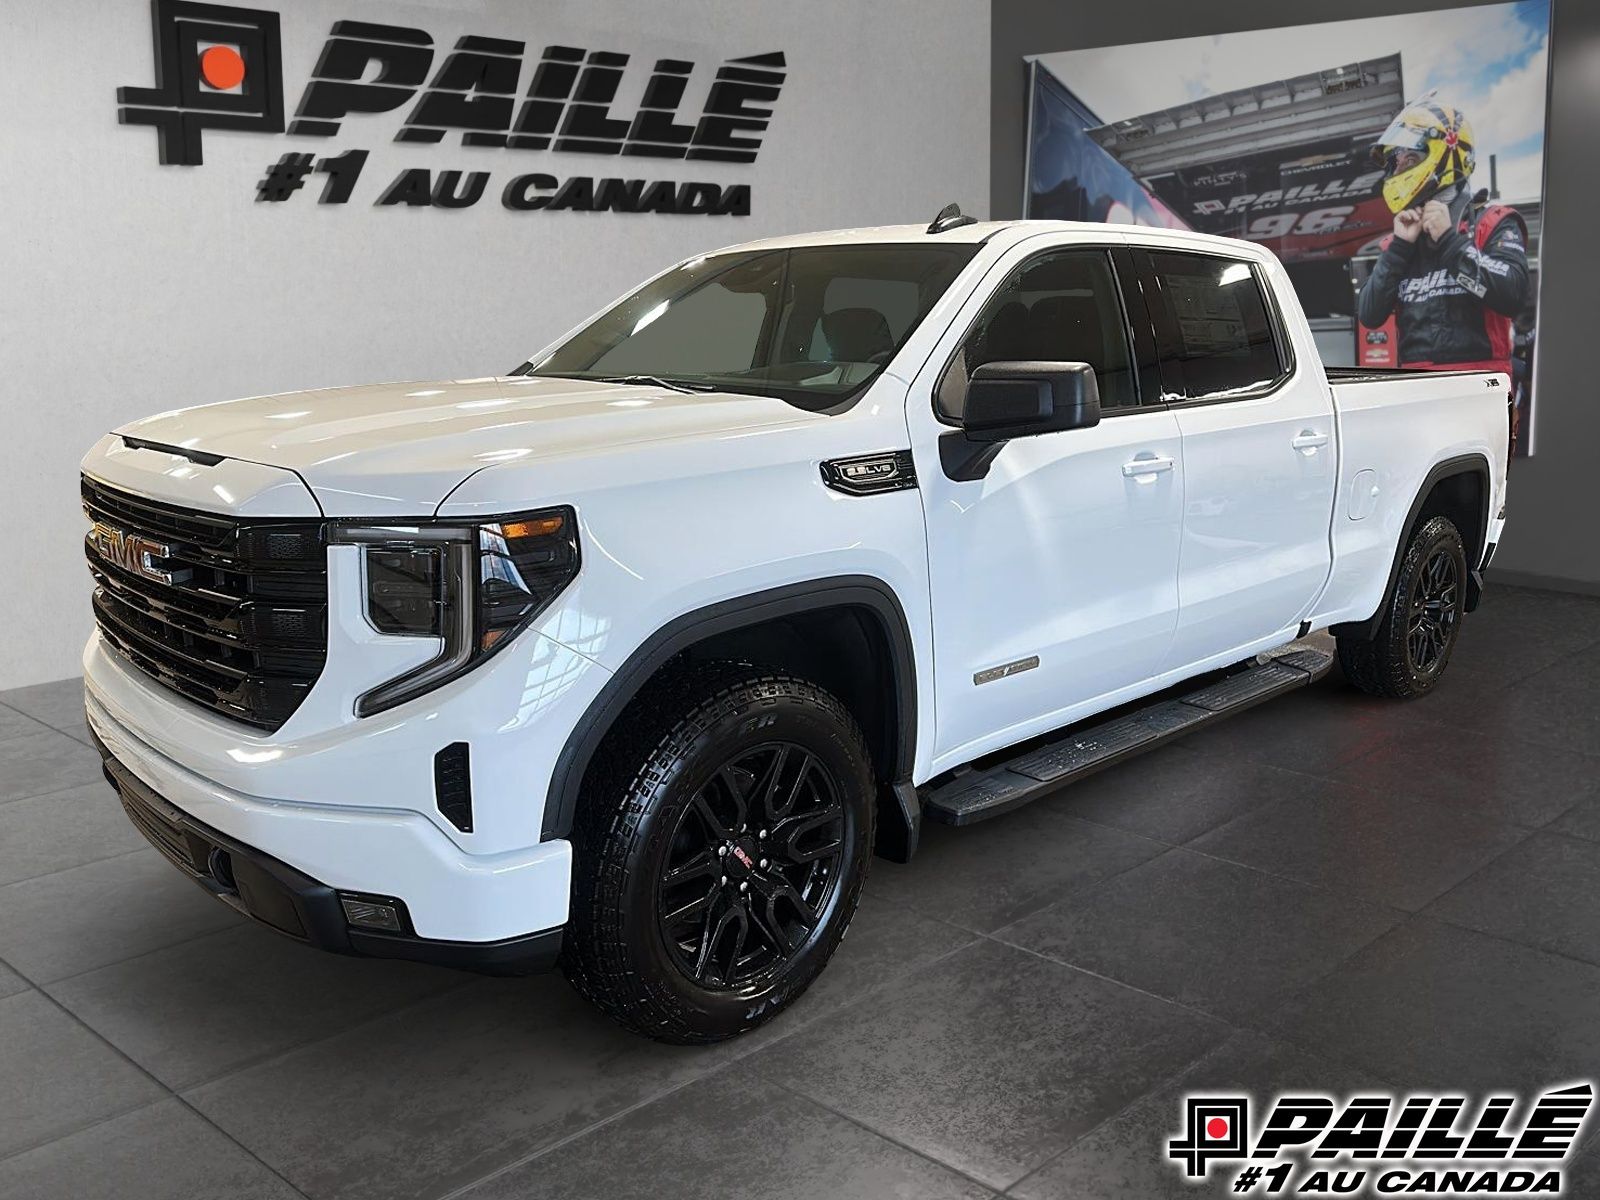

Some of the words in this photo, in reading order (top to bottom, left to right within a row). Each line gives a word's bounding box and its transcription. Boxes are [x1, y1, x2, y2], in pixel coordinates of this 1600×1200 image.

[286, 20, 787, 163] PAILLÉ
[254, 149, 369, 205] #1
[373, 168, 491, 209] AU
[501, 174, 751, 217] CANADA
[1280, 159, 1352, 176] CHEVROLET
[1250, 202, 1279, 212] AU
[1285, 188, 1373, 206] CANADA
[1250, 206, 1354, 240] 96
[94, 522, 172, 586] GMC
